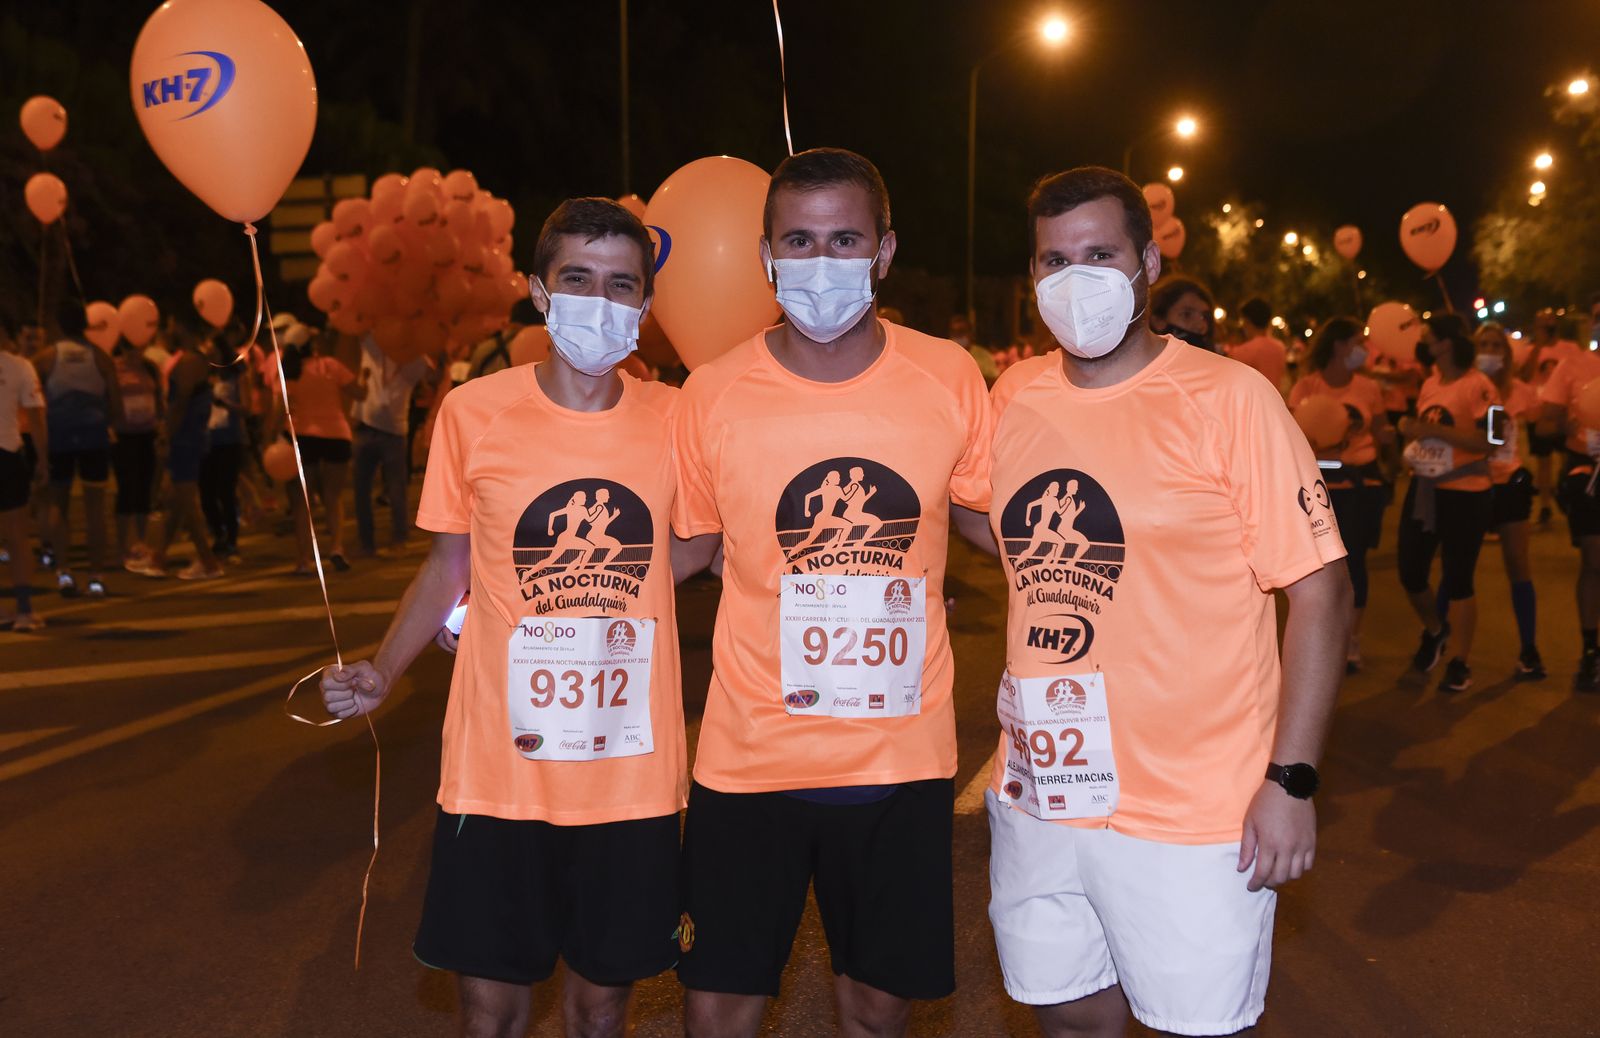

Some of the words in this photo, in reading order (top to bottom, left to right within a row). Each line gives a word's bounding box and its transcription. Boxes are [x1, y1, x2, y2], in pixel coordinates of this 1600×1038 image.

[806, 550, 904, 571] NOCTURNA
[521, 583, 544, 602] LA
[548, 573, 640, 599] NOCTURNA
[1016, 574, 1031, 592] LA
[1032, 568, 1114, 601] NOCTURNA
[535, 600, 554, 615] del
[555, 592, 627, 613] Guadalquivir
[1027, 590, 1036, 607] del
[1036, 588, 1101, 615] Guadalquivir
[803, 626, 908, 666] 9250
[530, 668, 628, 709] 9312
[1075, 772, 1114, 784] MACIAS
